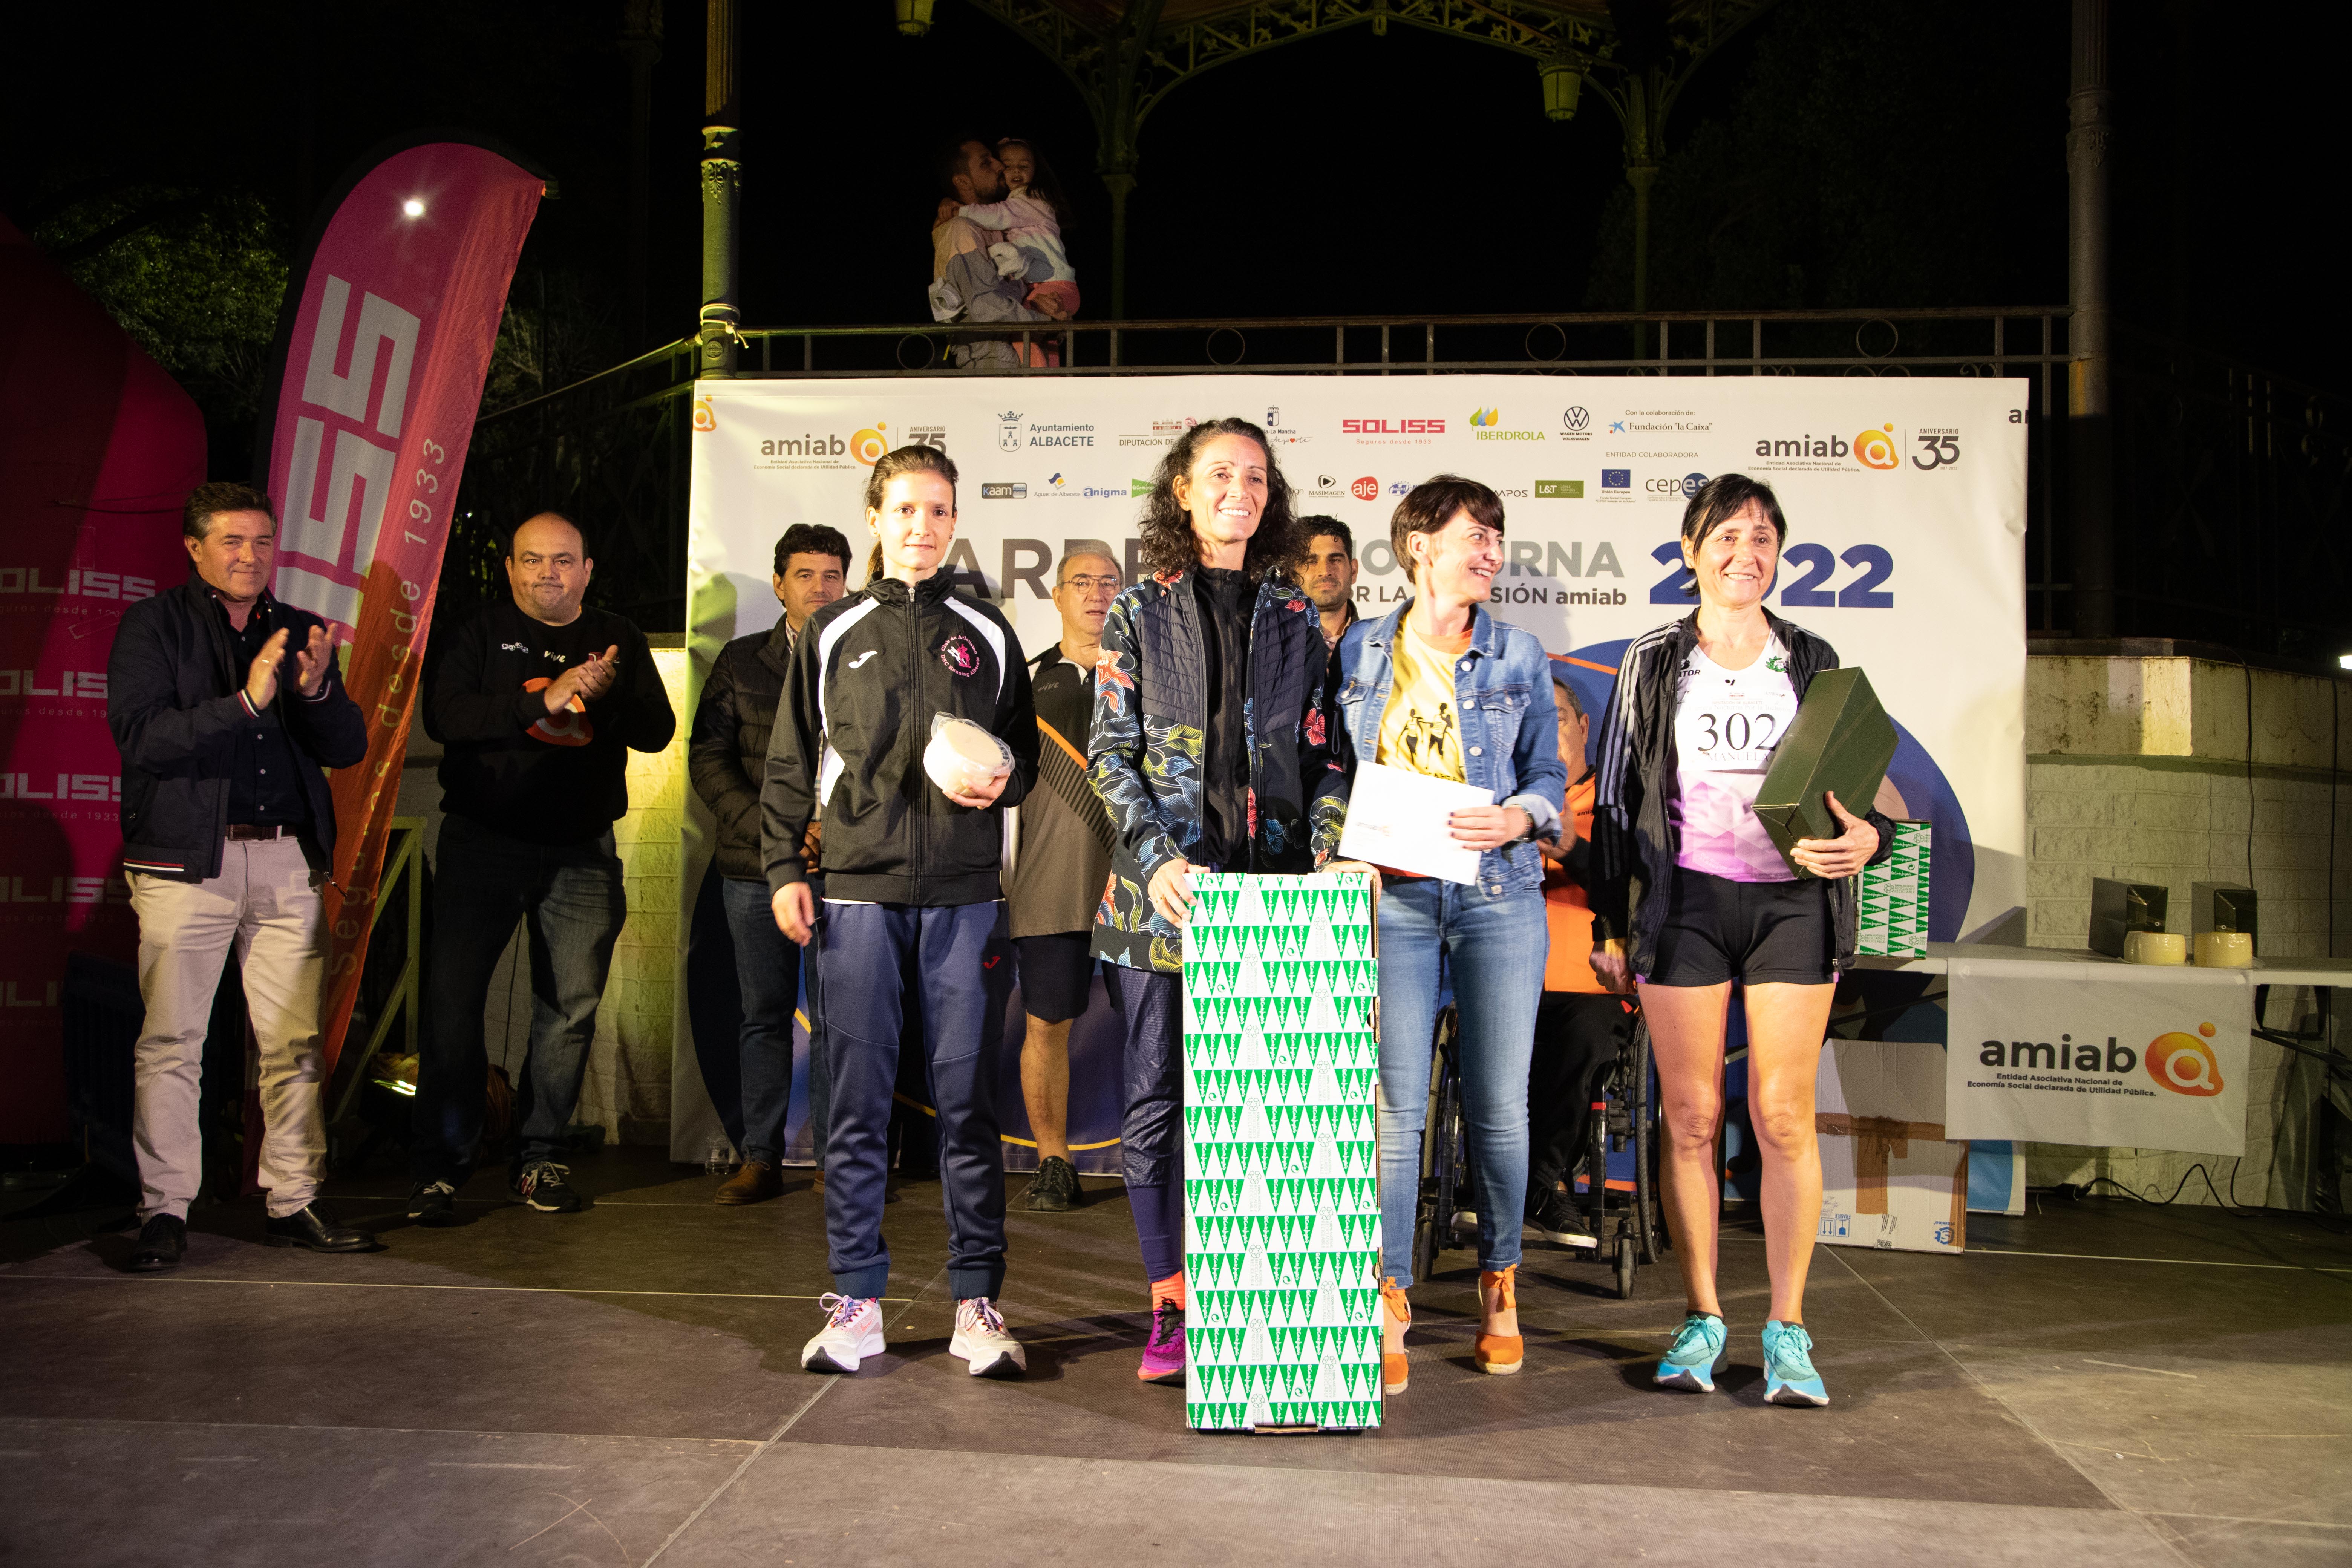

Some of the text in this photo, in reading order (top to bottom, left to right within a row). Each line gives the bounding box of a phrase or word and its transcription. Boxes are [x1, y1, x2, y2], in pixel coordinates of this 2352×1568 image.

[1030, 423, 1095, 433] Ayuntamiento
[1343, 419, 1445, 433] SOLISS
[1629, 422, 1672, 430] Fundación
[761, 433, 846, 456] amiab
[1029, 436, 1094, 447] ALBACETE
[1476, 431, 1545, 441] IBERDROLA
[1756, 433, 1848, 458] amiab
[1912, 436, 1960, 471] 35
[1353, 481, 1377, 497] aje
[1539, 485, 1557, 494] L&T
[0, 567, 156, 602] OLISS
[378, 579, 421, 729] desde
[404, 438, 444, 545] 1933
[1556, 587, 1626, 605] amiab
[941, 640, 950, 651] Club
[958, 635, 977, 654] Atletismo
[940, 654, 980, 678] DSC Running Albacete
[0, 669, 108, 700] OLIS
[1697, 713, 1777, 752] 302
[87, 811, 119, 822] 1933
[1980, 1033, 2137, 1073] amiab
[1996, 1072, 2028, 1081] Entidad
[2030, 1074, 2073, 1084] Asociativa
[2075, 1076, 2110, 1086] Nacional
[1967, 1081, 2006, 1089] Economía
[2007, 1081, 2032, 1090] Social
[2034, 1083, 2074, 1093] declarada
[2089, 1086, 2121, 1095] Utilidad
[2123, 1088, 2157, 1098] Pública.
